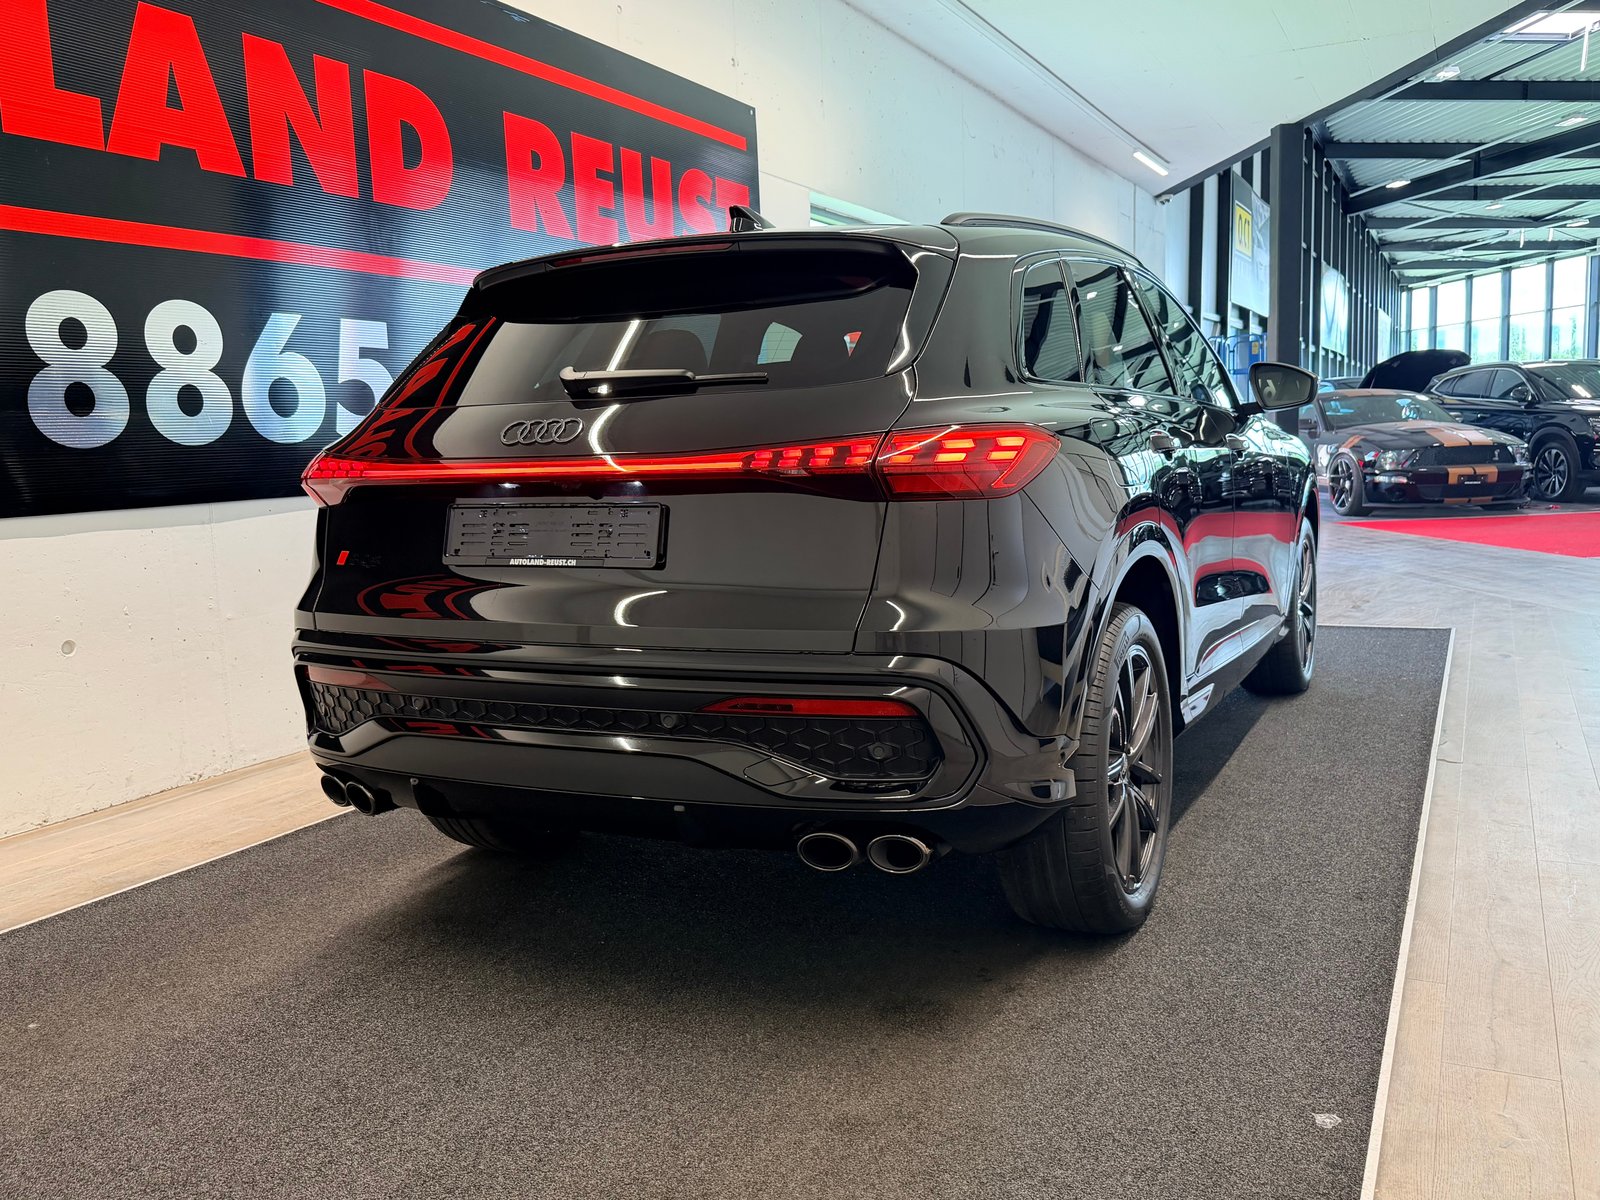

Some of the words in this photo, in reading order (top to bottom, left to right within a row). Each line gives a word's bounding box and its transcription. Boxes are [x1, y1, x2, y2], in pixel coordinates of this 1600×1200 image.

[502, 110, 750, 246] REUST
[25, 289, 396, 449] 8865
[509, 558, 577, 566] AUTOLAND-REUST.CH
